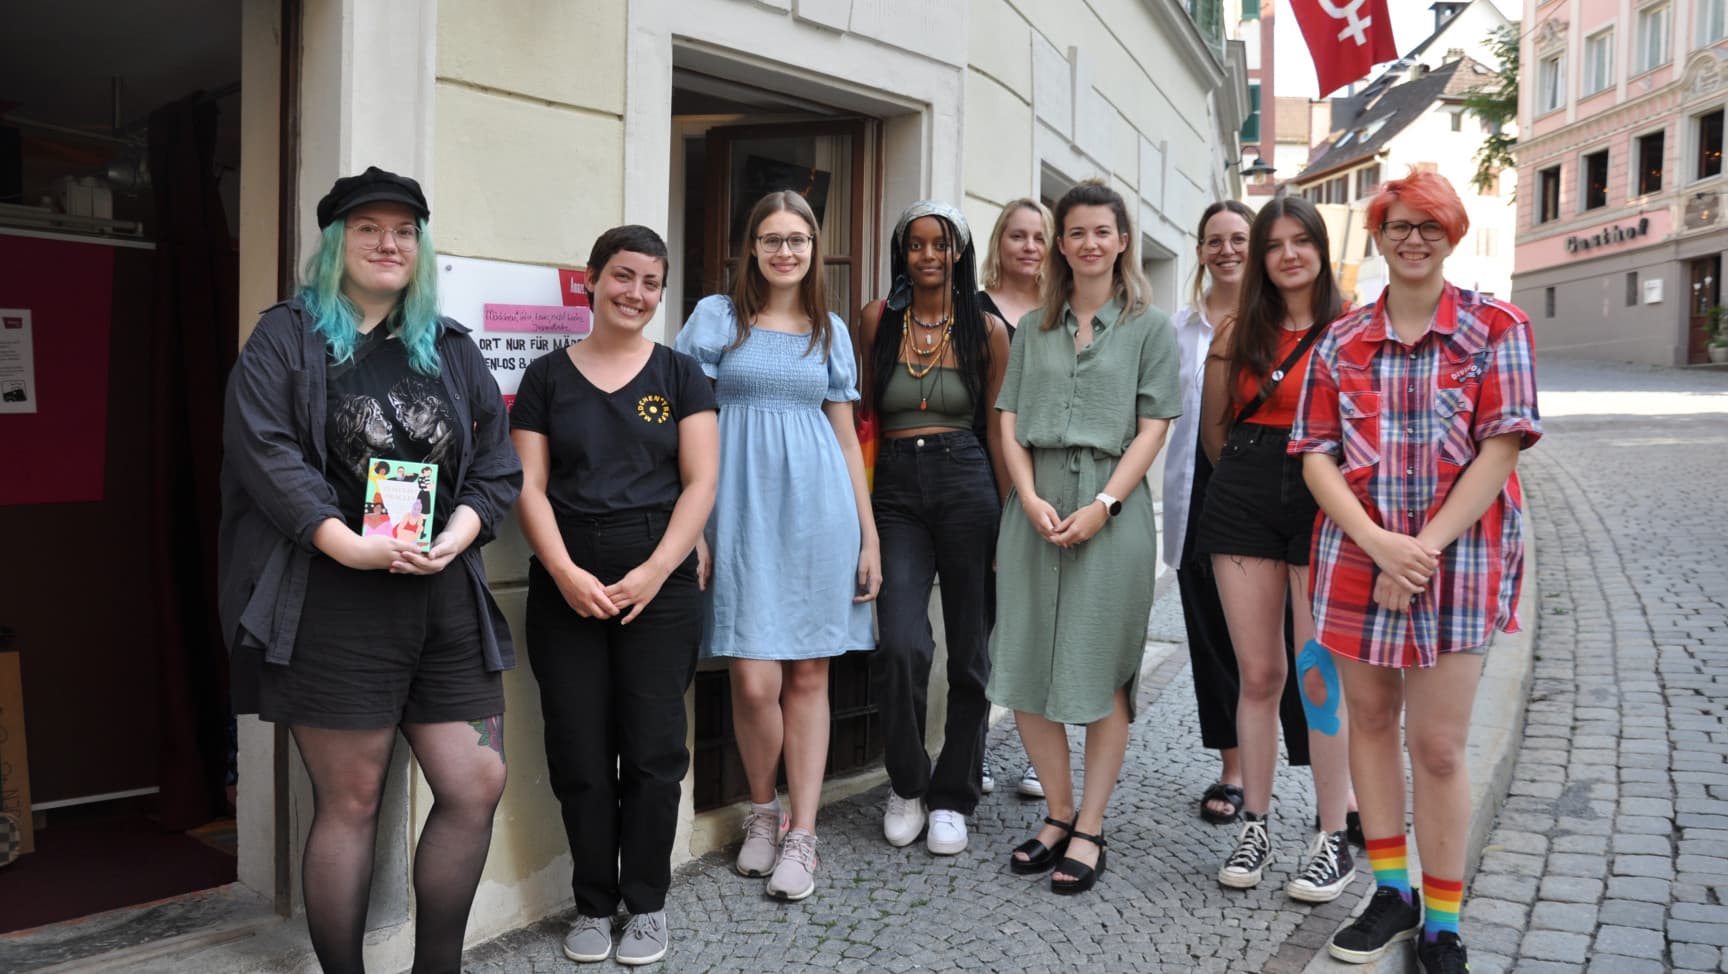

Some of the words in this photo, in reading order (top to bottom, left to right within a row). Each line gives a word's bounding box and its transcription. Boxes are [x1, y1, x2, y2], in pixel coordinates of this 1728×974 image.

[506, 338, 525, 351] NUR
[531, 336, 549, 351] FÜR
[485, 358, 515, 371] ENLOS
[519, 358, 527, 369] &
